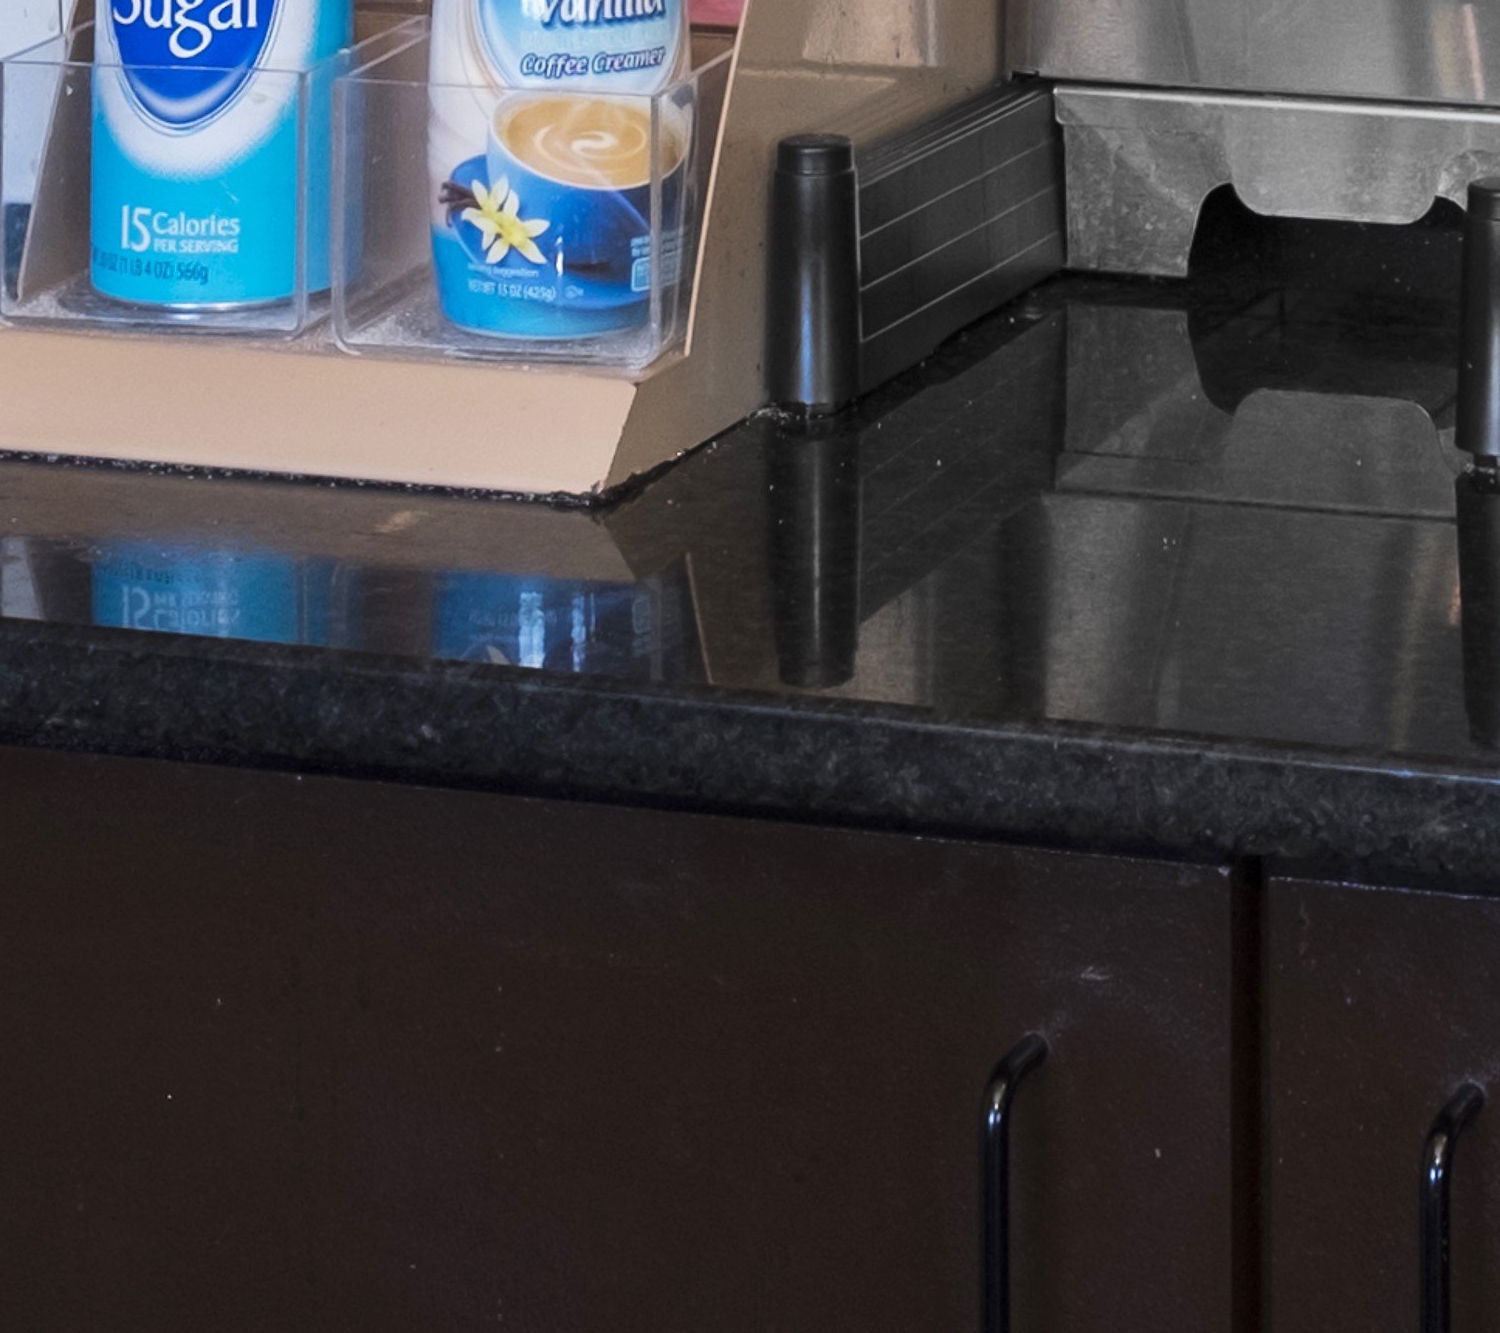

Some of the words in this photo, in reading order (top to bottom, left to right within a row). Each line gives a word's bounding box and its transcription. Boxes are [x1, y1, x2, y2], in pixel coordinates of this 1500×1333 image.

[521, 51, 590, 78] Coffee
[592, 45, 666, 74] Creamer
[121, 204, 151, 253] 15
[152, 211, 241, 237] Calories
[153, 238, 178, 253] PER
[178, 239, 239, 254] SERVING
